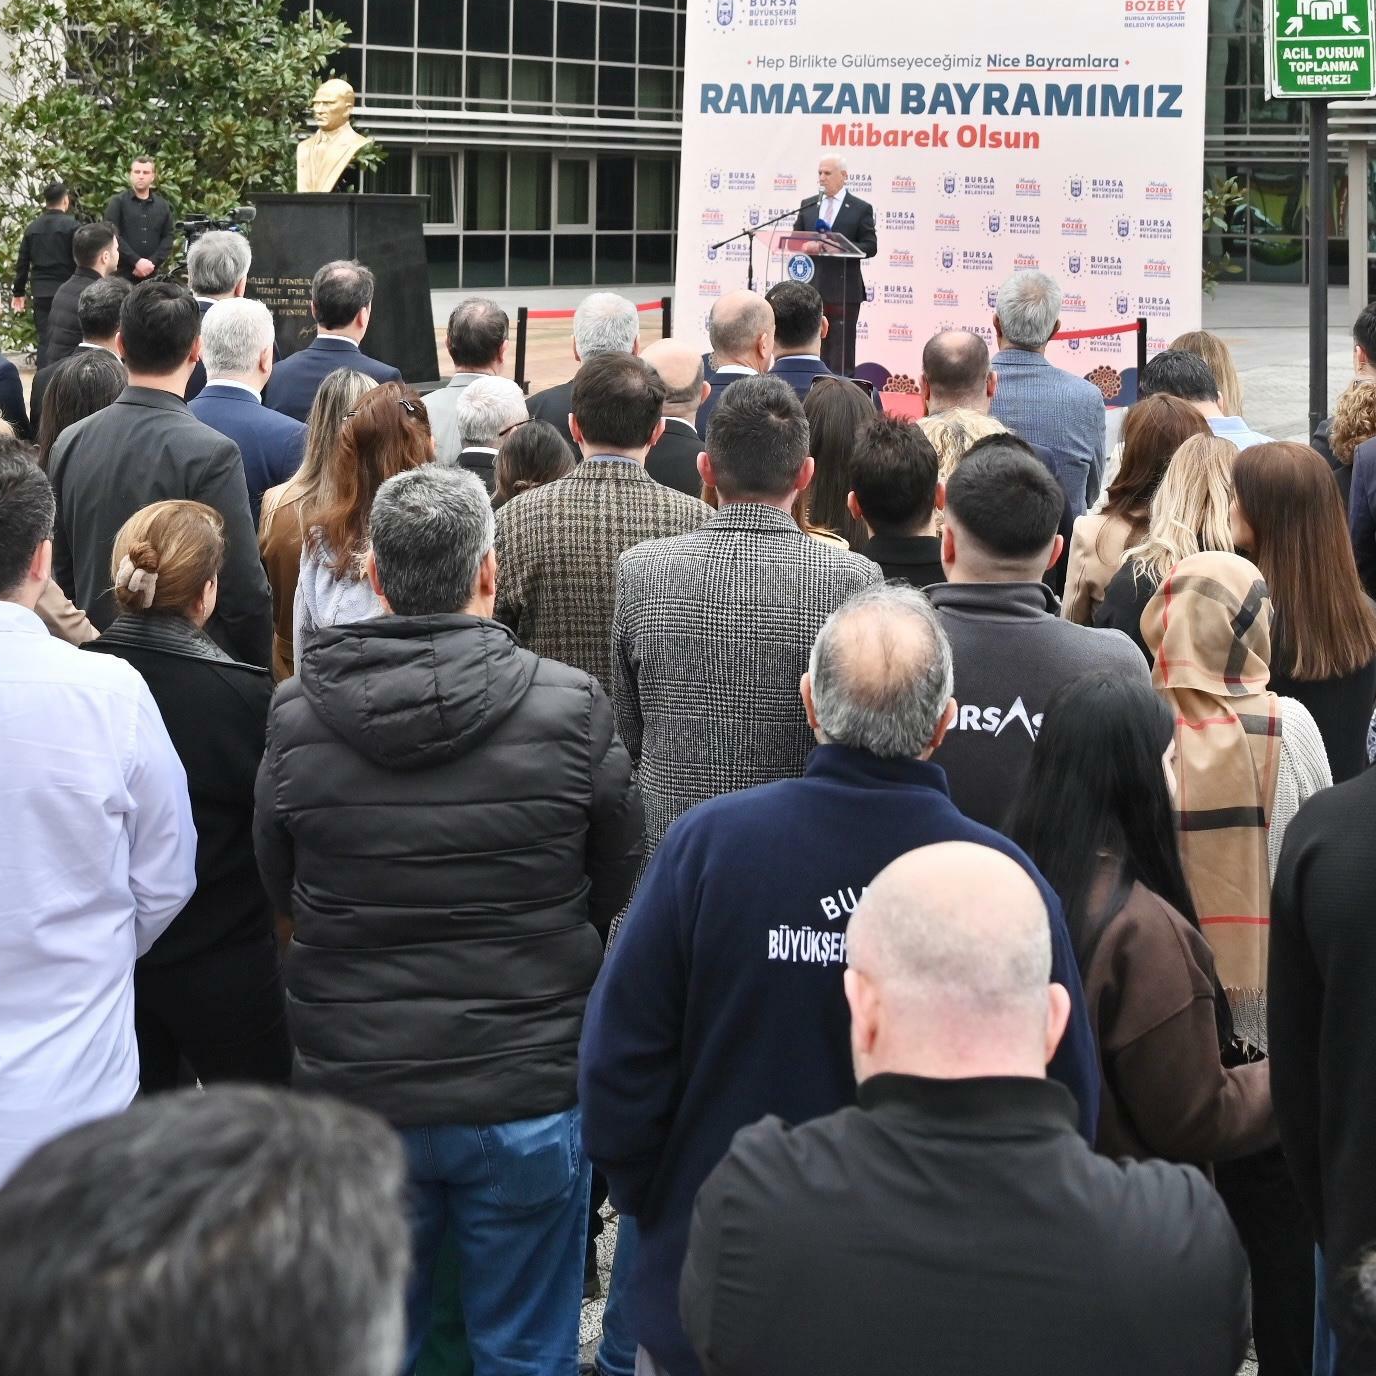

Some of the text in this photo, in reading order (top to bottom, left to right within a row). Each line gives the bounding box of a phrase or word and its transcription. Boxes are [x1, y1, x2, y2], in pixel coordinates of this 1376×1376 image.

[1125, 0, 1186, 11] BOZBEY
[749, 7, 797, 17] BÜYÜKŞEHİR
[749, 18, 797, 26] BELEDİYESİ
[1316, 46, 1364, 59] DURUM
[756, 54, 1119, 71] Hep Birlikte Gülümseyeceğimiz Nice Bayramlara
[1288, 61, 1358, 72] TOPLANMA
[700, 83, 1183, 118] RAMAZAN BAYRAMIMIZ
[821, 123, 1040, 149] Mübarek Olsun
[1092, 179, 1123, 187] BURSA
[768, 924, 848, 967] BÜYÜKŞEH
